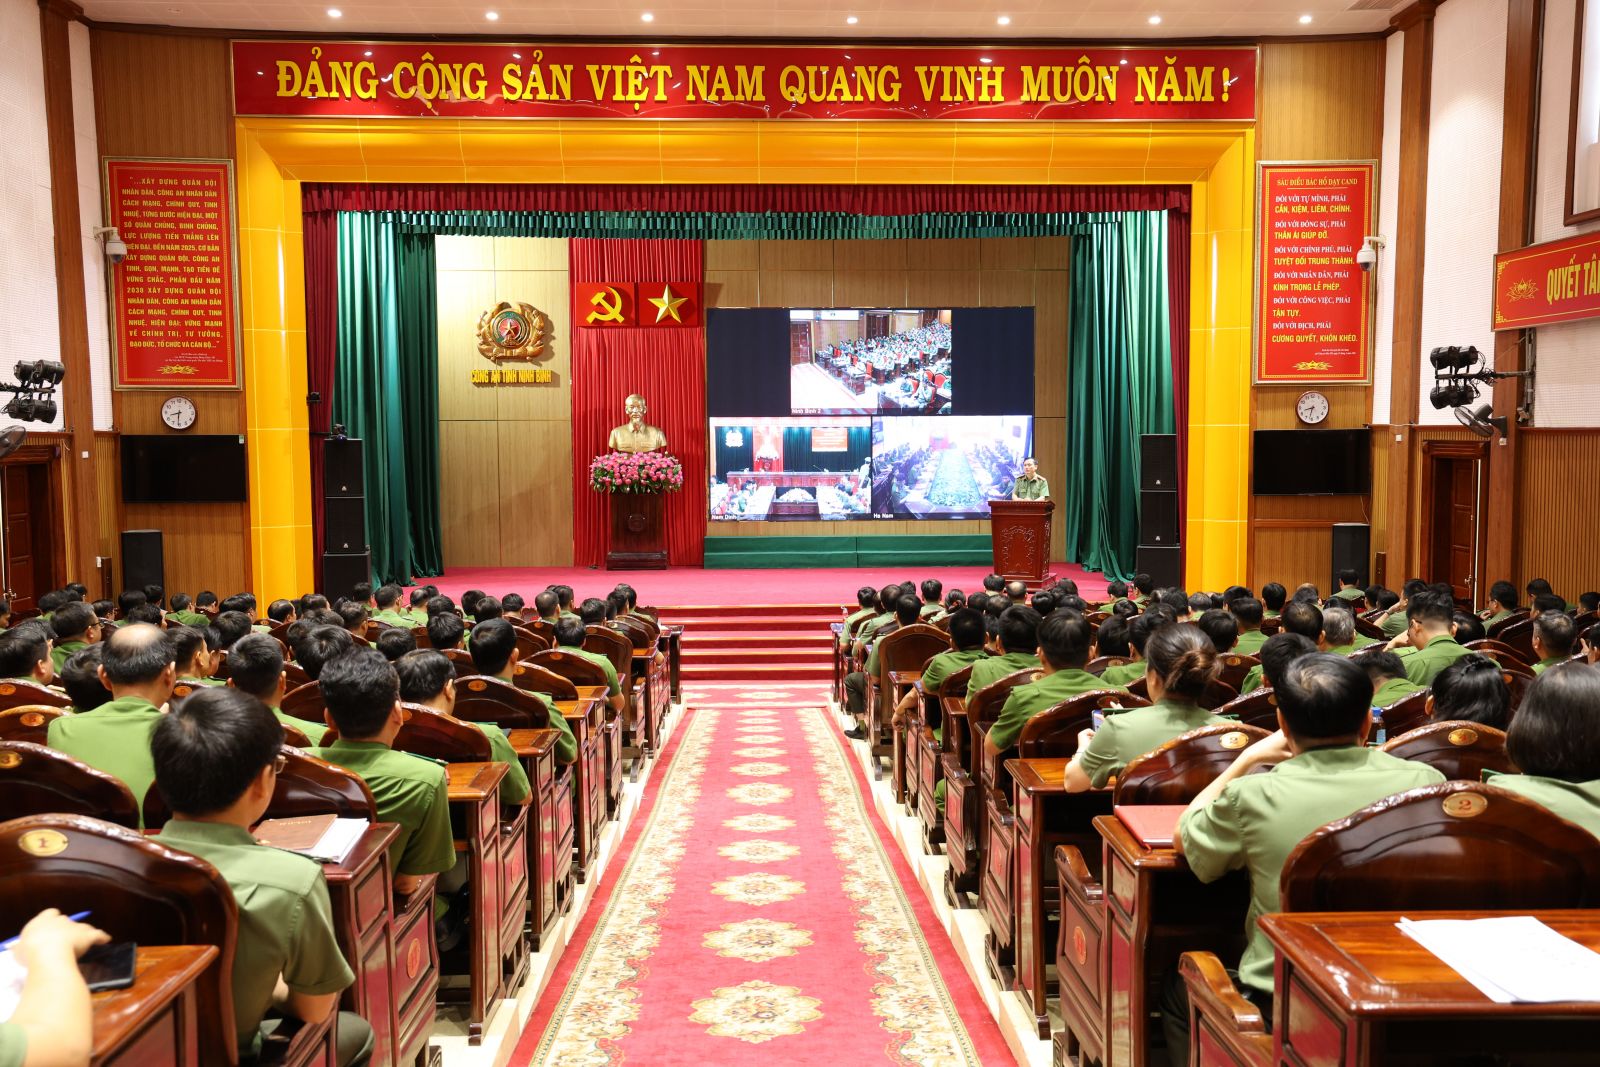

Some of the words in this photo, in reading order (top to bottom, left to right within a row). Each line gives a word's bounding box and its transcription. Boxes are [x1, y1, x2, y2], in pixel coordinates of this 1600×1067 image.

[276, 46, 379, 101] ĐẢNG
[392, 52, 488, 109] CỘNG
[501, 49, 574, 102] SẢN
[586, 54, 673, 111] VIỆT
[685, 64, 766, 102] NAM
[779, 64, 902, 105] QUANG
[914, 64, 1005, 103] VINH
[1019, 55, 1120, 103] MUÔN
[1547, 254, 1581, 305] QUYẾT
[1584, 253, 1600, 296] TÂ
[1458, 800, 1472, 811] 2
[39, 838, 48, 848] 1
